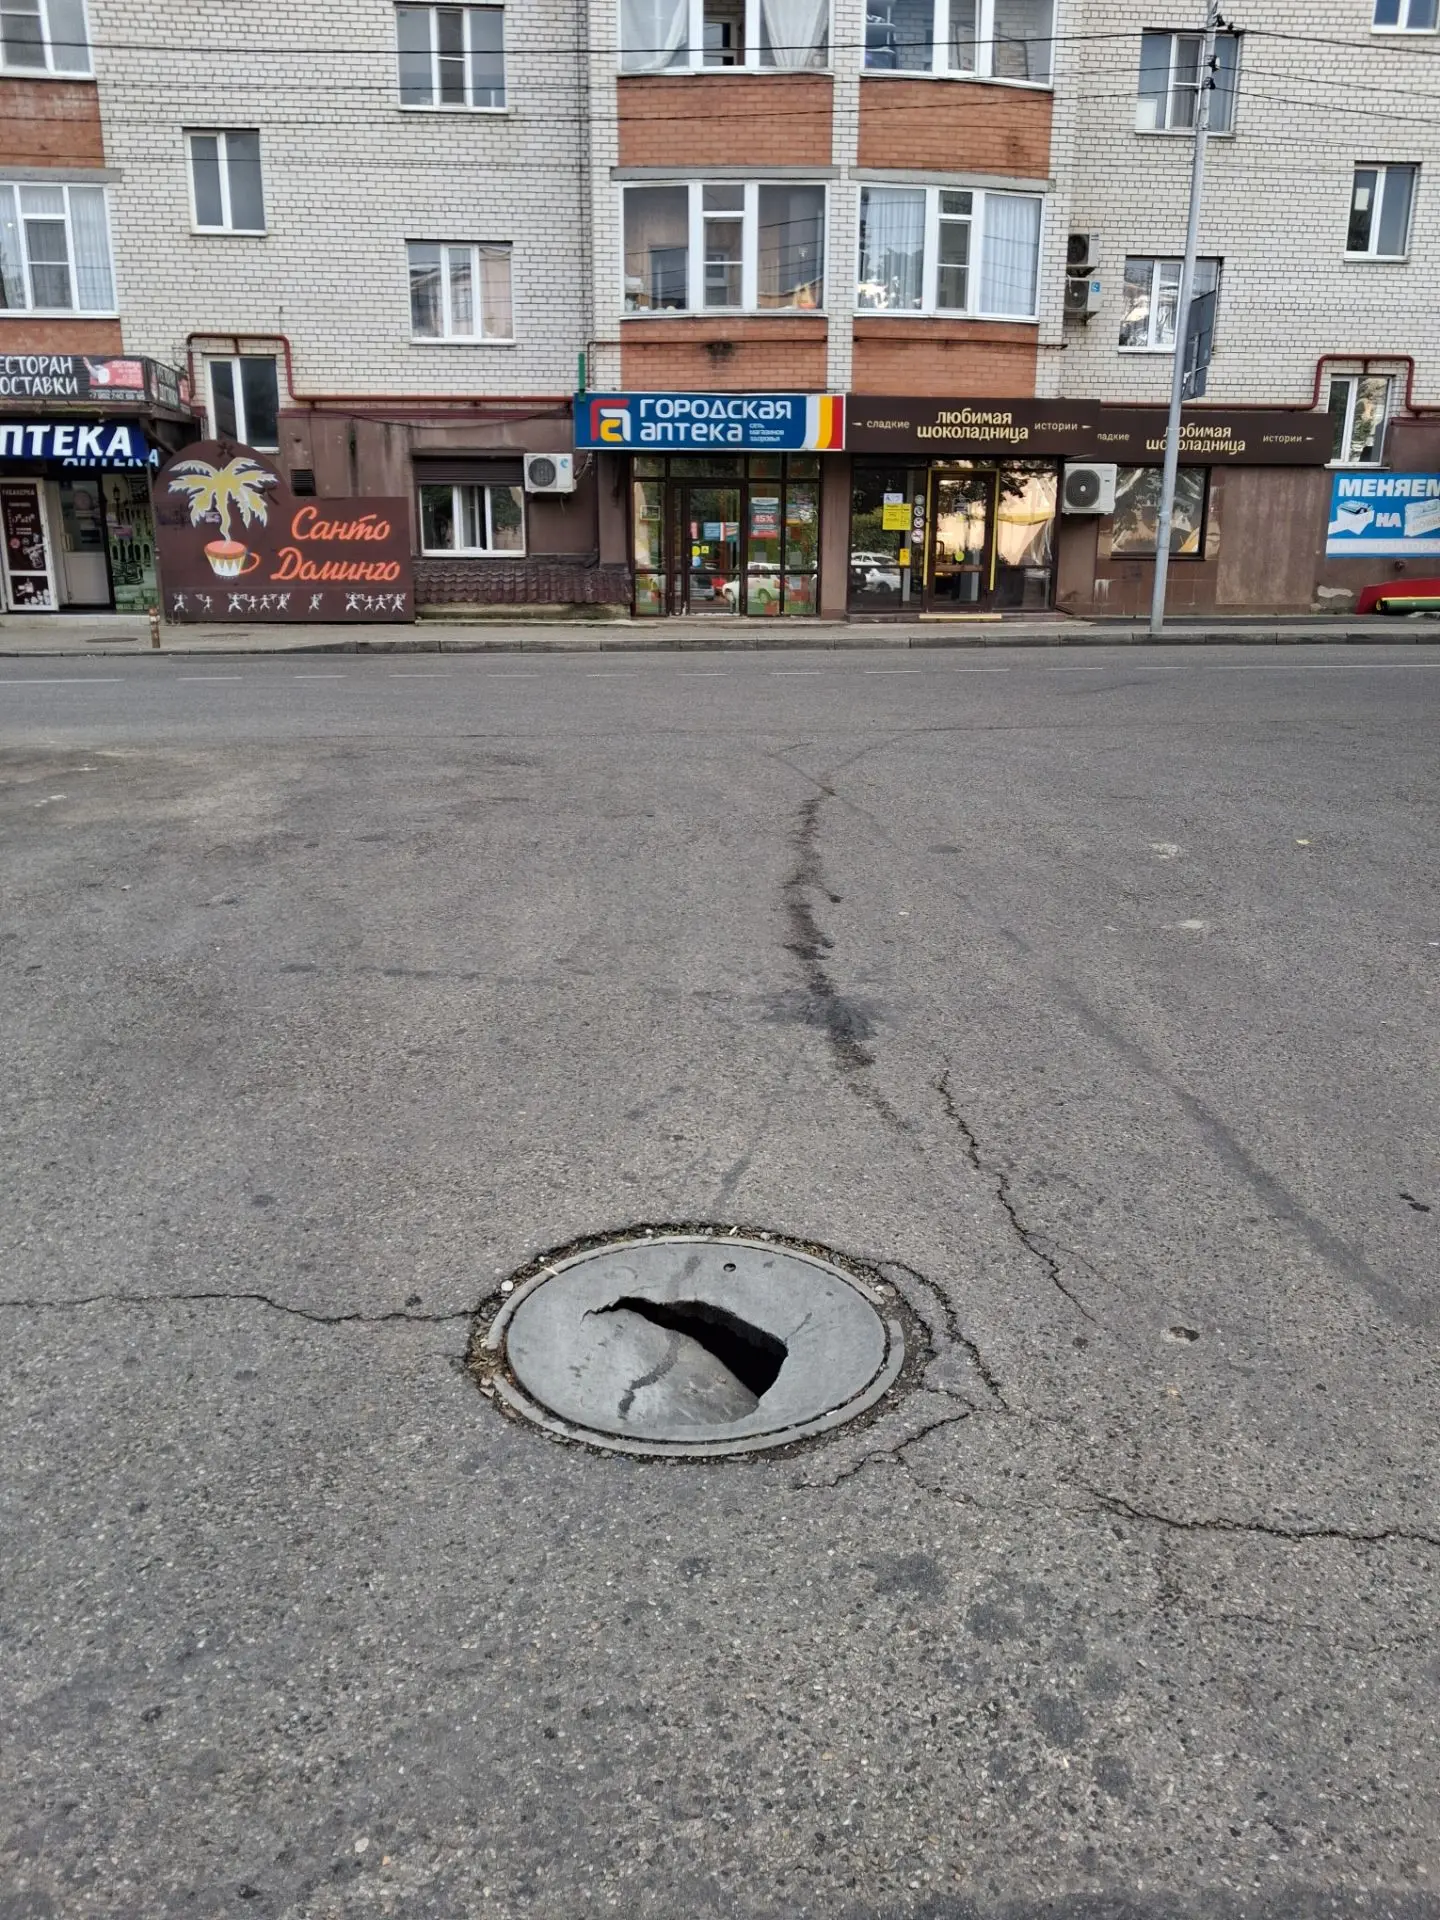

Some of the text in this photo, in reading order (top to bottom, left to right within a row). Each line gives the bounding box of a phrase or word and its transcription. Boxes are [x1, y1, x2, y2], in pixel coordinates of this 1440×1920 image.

[0, 376, 79, 397] ОСТАВКИ
[935, 407, 1013, 425] любимая
[0, 424, 132, 457] ПТЕКА
[639, 422, 743, 442] аптека
[866, 419, 1079, 444] сладкие шоколадница истории
[1145, 439, 1246, 455] шооладница
[1262, 434, 1303, 444] истории
[1338, 478, 1440, 497] МЕНЯЕМ
[291, 506, 391, 540] Санто
[1375, 512, 1402, 528] НА
[269, 547, 401, 581] Доминго
